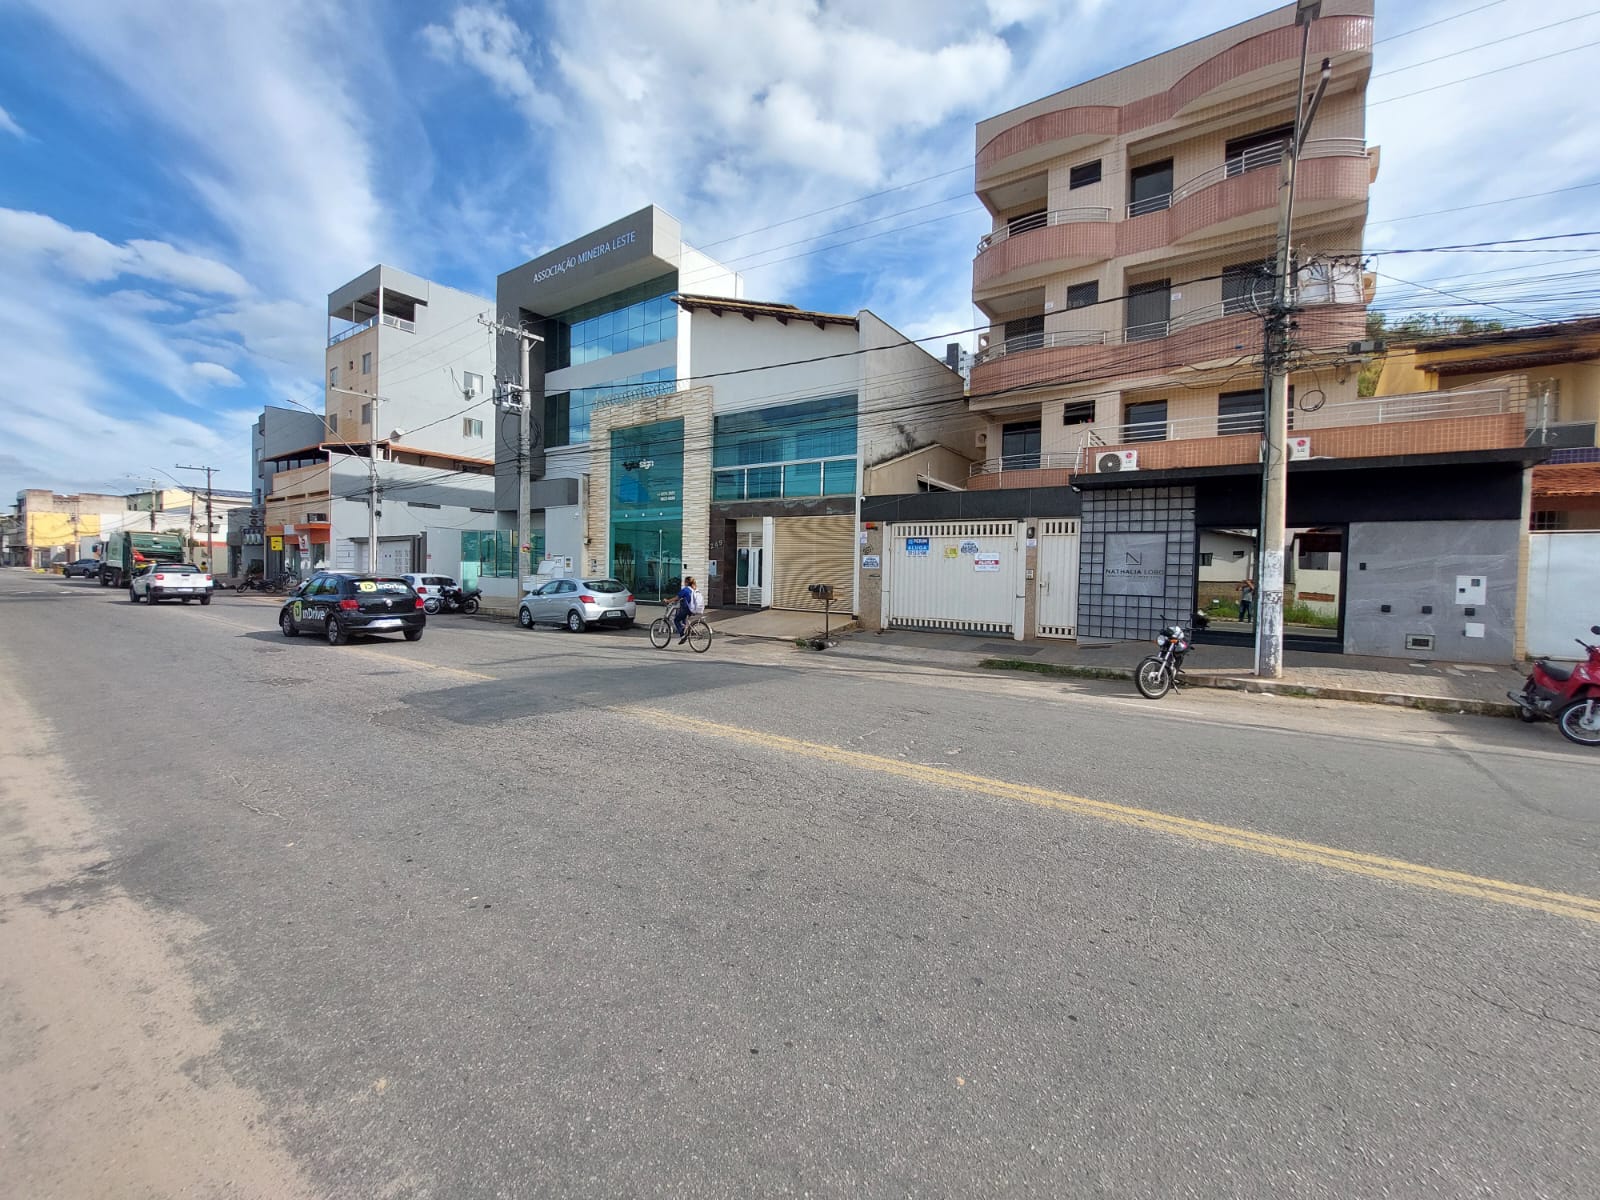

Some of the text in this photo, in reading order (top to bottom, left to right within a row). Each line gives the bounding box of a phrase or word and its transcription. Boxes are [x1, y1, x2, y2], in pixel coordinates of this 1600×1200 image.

[533, 231, 636, 284] ASSOCIAÇÃO MINEIRA LESTE
